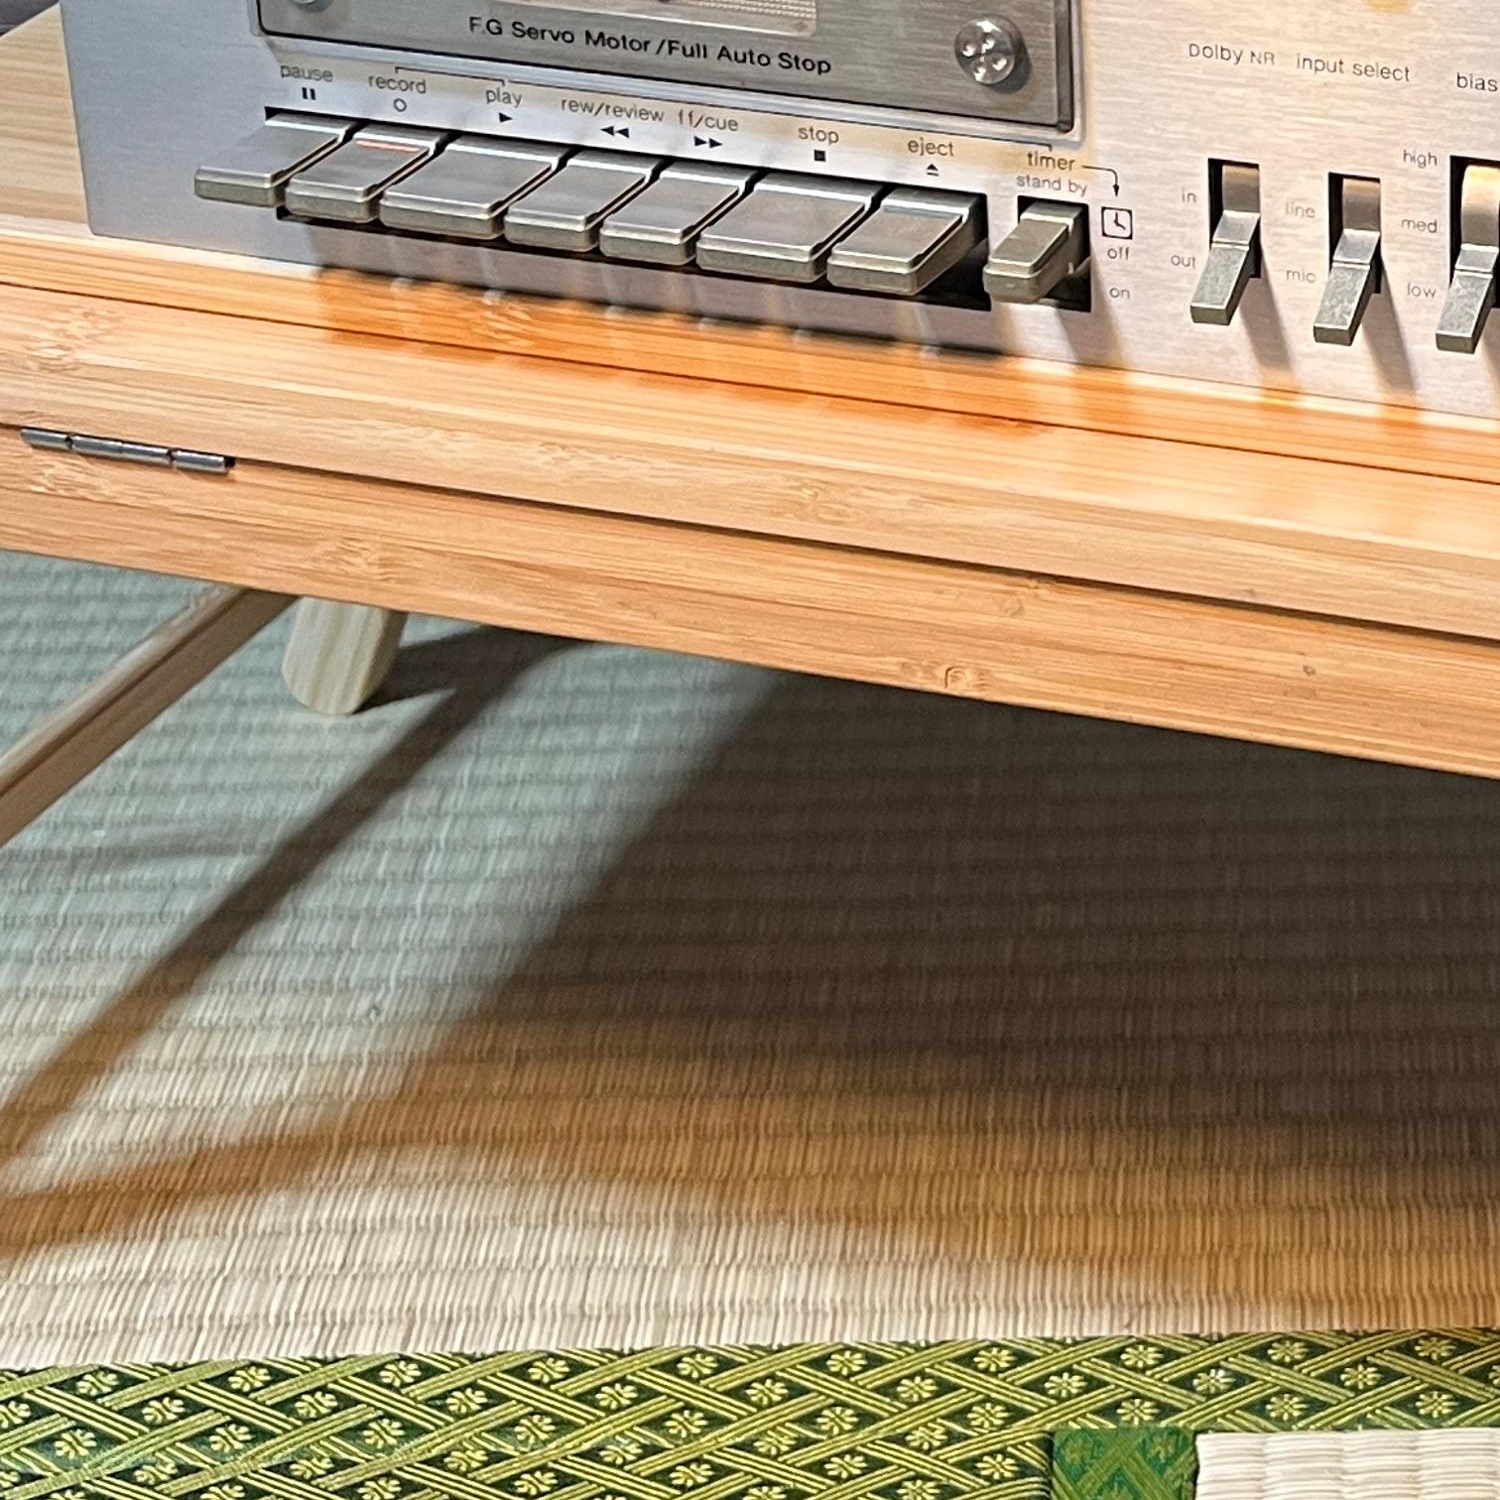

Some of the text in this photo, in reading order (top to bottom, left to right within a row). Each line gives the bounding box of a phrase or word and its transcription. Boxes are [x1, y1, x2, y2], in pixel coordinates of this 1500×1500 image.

[511, 21, 575, 44] Servo
[717, 45, 771, 68] Auto
[778, 53, 832, 76] Stop
[1189, 43, 1276, 66] Dolby NR
[280, 65, 333, 82] pause
[1296, 53, 1411, 83] input select
[368, 73, 427, 94] record
[1456, 72, 1498, 93] bias
[486, 87, 523, 108] play
[561, 99, 664, 121] rew/review
[797, 125, 839, 145] stop
[907, 138, 955, 159] eject
[1027, 151, 1075, 171] timer
[1402, 149, 1438, 169] high
[1016, 175, 1088, 197] stand by
[1182, 188, 1197, 203] in
[1285, 201, 1316, 219] line
[1401, 217, 1439, 234] med
[1171, 254, 1196, 269] out
[1286, 268, 1316, 284] mic
[1109, 287, 1130, 299] on
[1407, 283, 1437, 299] low
